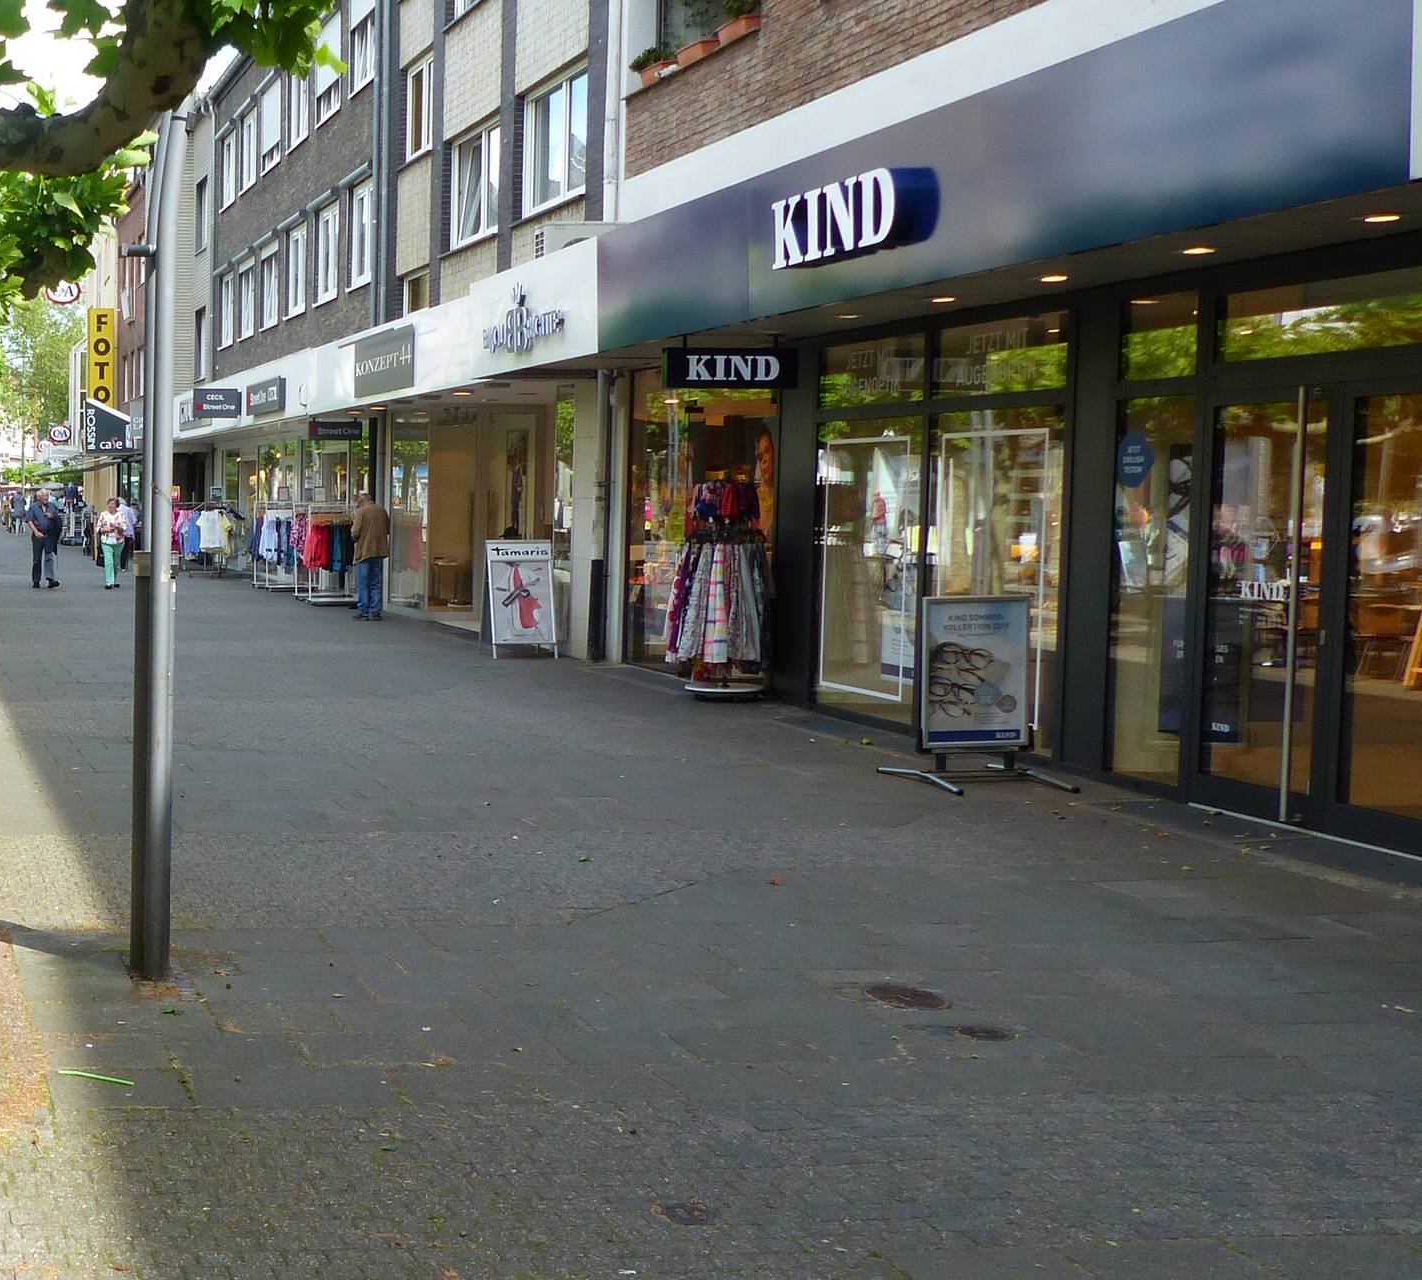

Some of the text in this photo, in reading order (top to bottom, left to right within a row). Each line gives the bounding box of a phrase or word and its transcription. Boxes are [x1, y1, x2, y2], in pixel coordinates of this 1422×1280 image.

[771, 167, 895, 270] KIND
[93, 313, 111, 404] FOTO
[355, 343, 411, 377] KONZEPT 44
[686, 355, 780, 381] KIND
[202, 403, 222, 411] Street
[86, 408, 96, 450] ROSSINI
[317, 427, 361, 436] Street One
[1238, 580, 1285, 601] KIND
[948, 614, 967, 622] KIND
